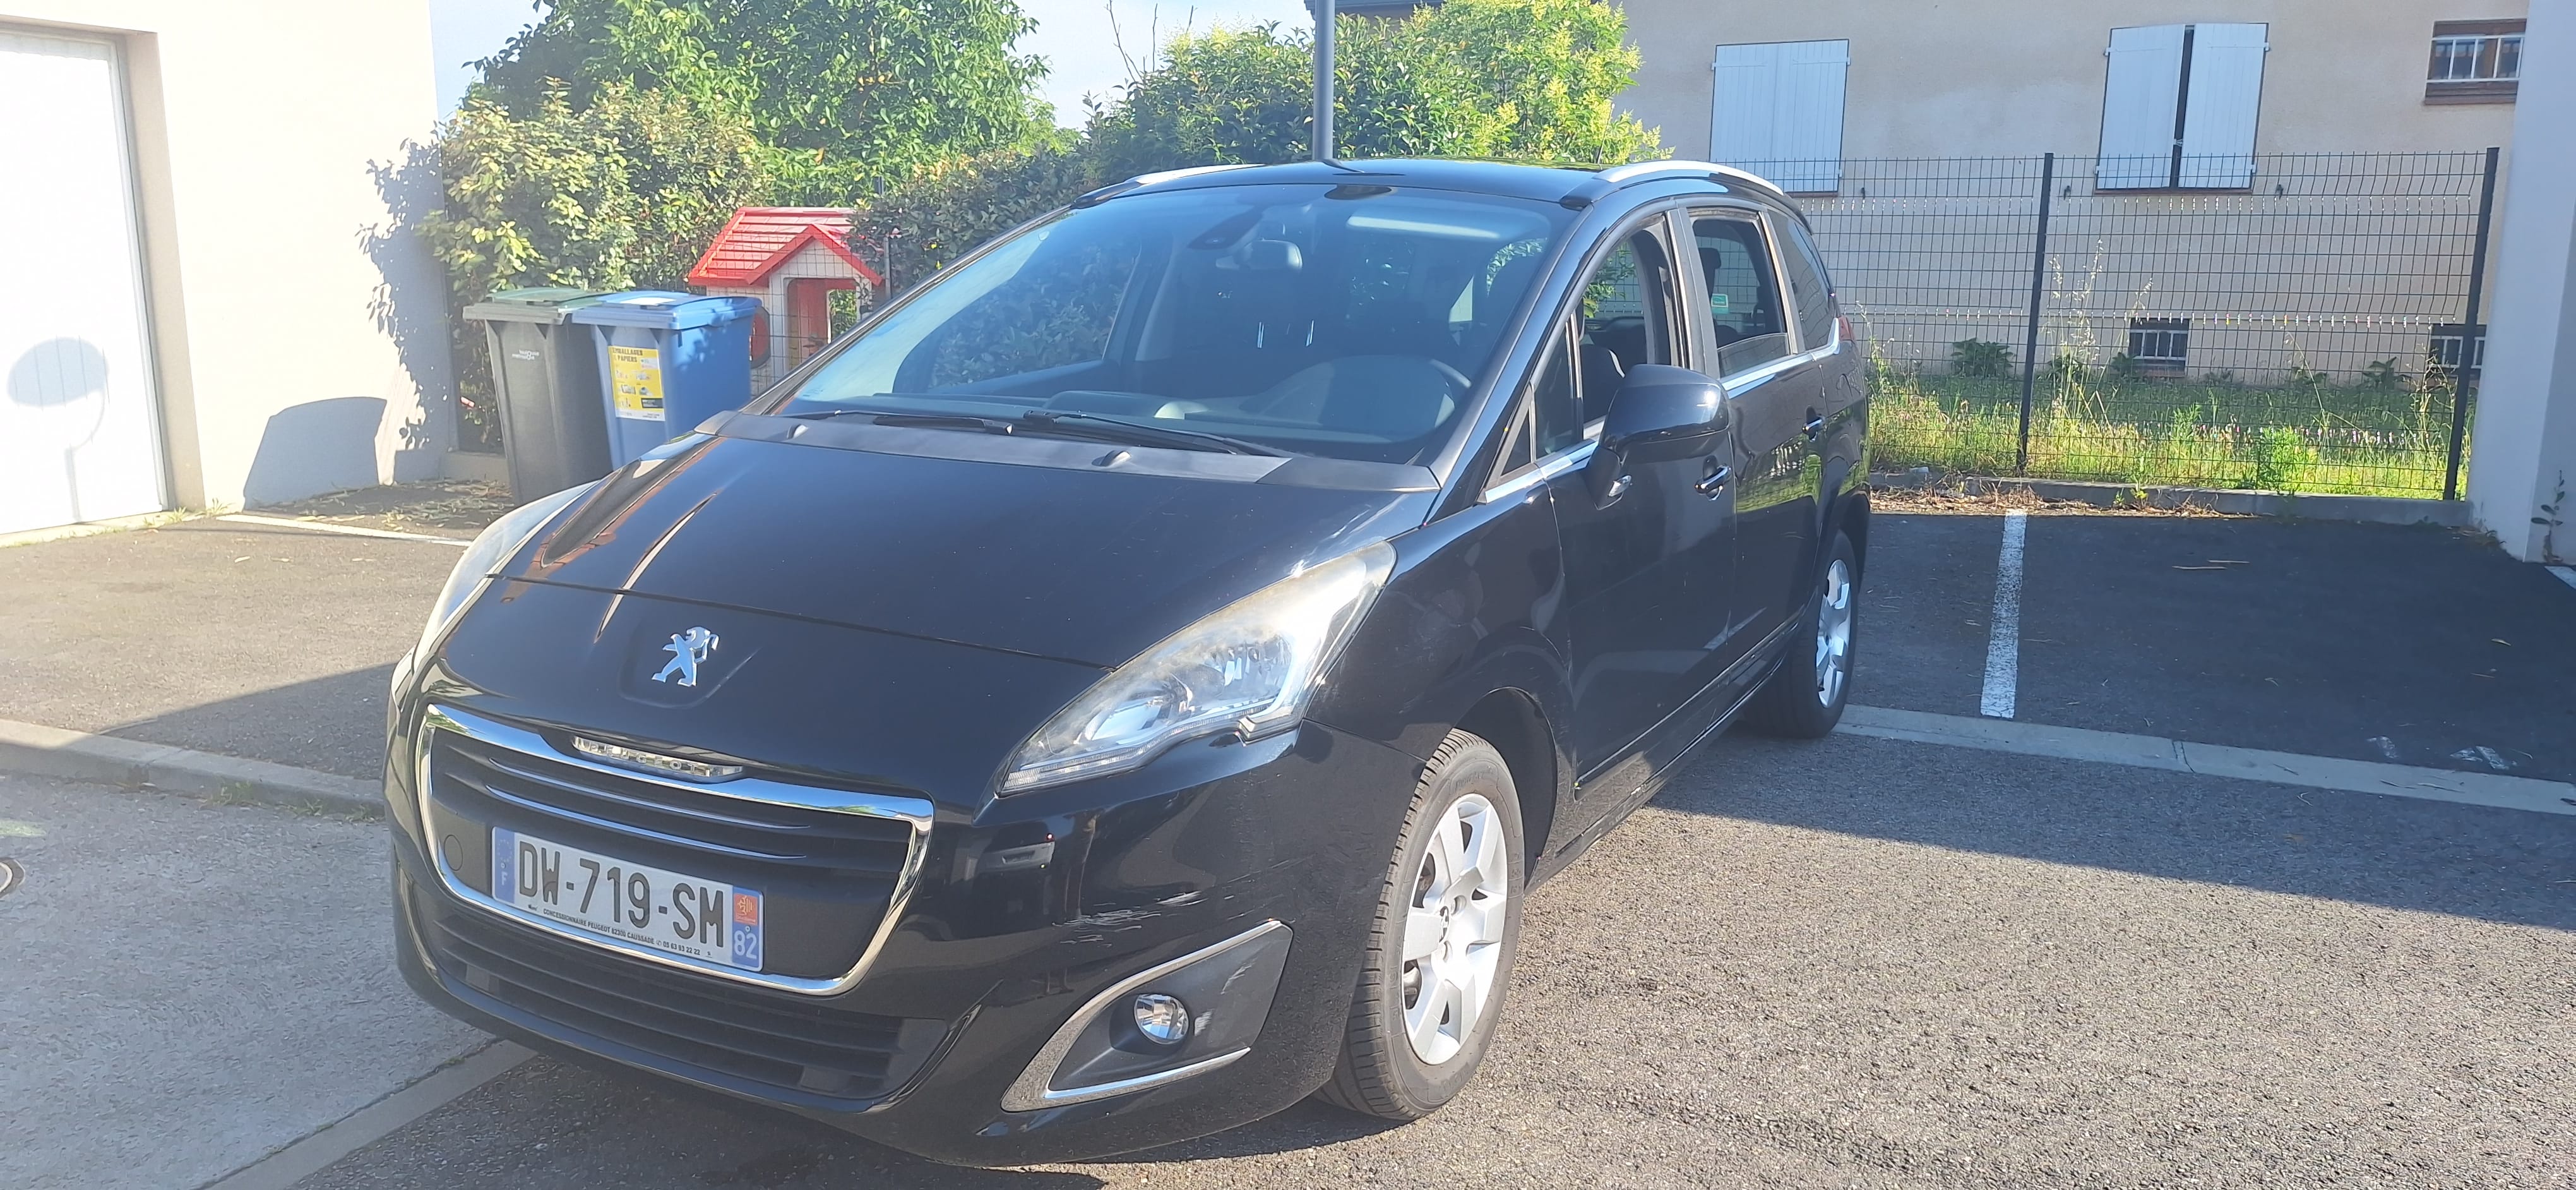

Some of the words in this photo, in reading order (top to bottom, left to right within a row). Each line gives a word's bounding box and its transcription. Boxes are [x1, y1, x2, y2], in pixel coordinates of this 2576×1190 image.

[502, 872, 508, 886] F
[520, 841, 723, 947] DW-719-SM
[543, 908, 587, 927] CONCESSIONNAIRE
[588, 921, 611, 932] PEUGEOT
[611, 929, 626, 937] 82300
[627, 932, 654, 944] CAUSSADE
[734, 930, 756, 959] 82
